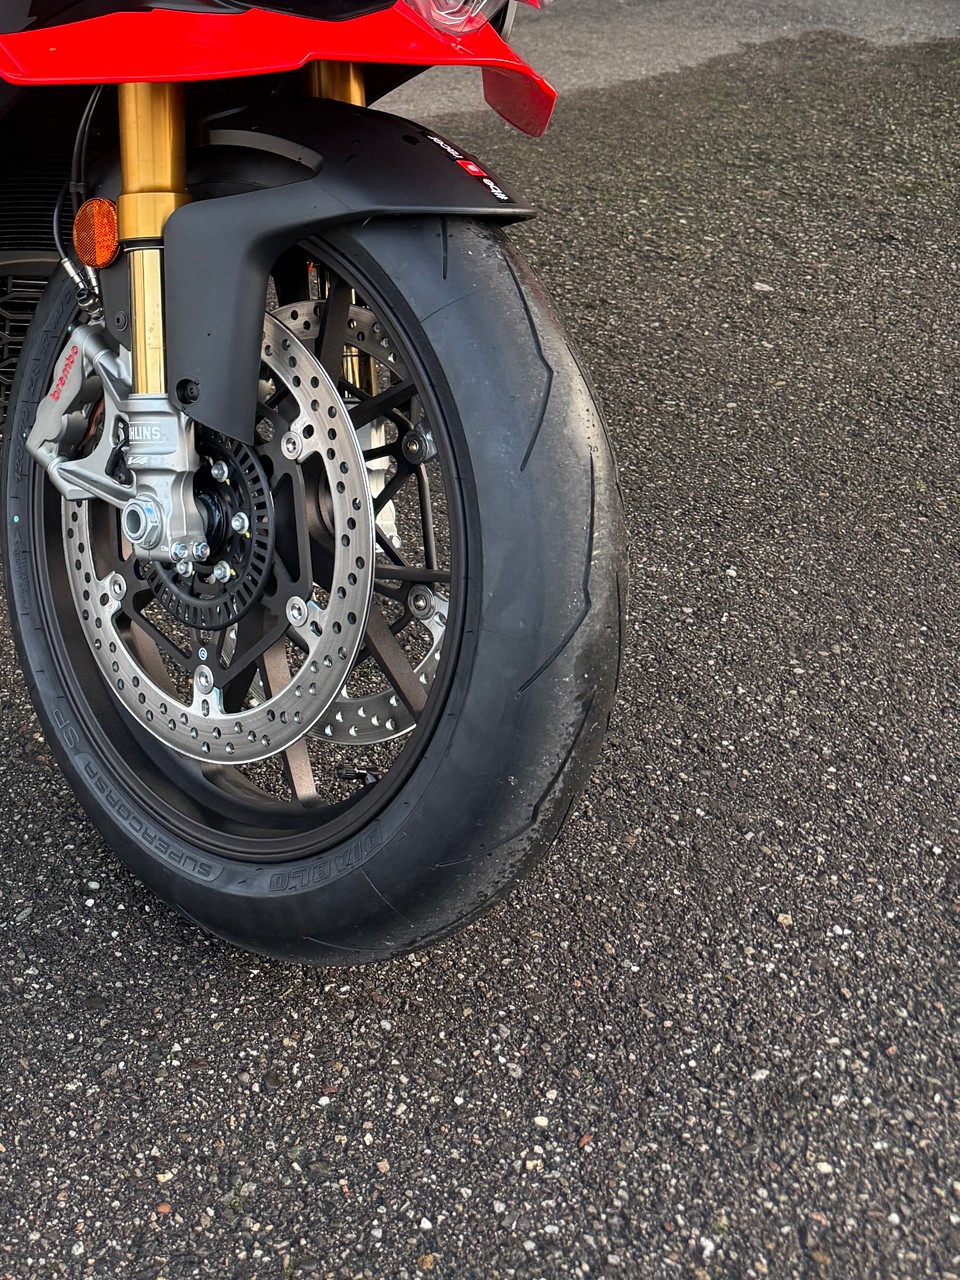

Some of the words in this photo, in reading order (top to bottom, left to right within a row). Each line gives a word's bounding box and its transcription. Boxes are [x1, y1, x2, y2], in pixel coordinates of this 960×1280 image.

[50, 345, 78, 402] brembo
[128, 425, 161, 440] HLINS
[83, 761, 213, 877] SUPERCORSA
[269, 821, 382, 891] DIABLO
